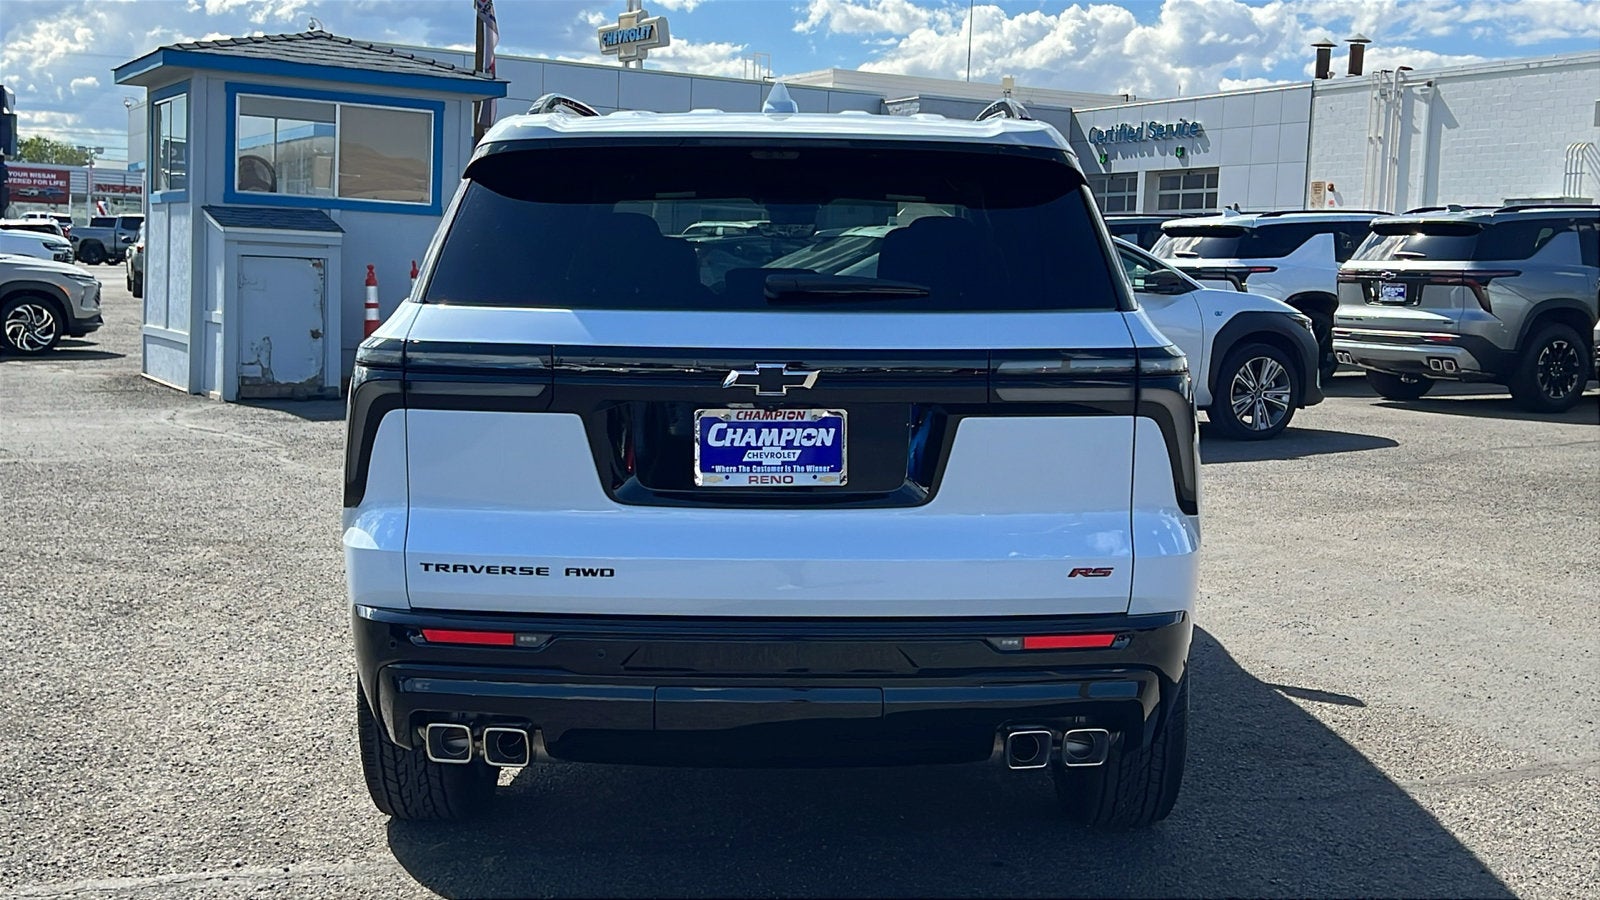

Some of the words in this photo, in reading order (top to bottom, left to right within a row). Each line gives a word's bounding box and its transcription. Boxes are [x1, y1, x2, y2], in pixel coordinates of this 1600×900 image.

[602, 25, 654, 46] CHEVROLET
[1089, 122, 1144, 144] Certified
[1148, 120, 1199, 139] Service
[736, 411, 806, 420] CHAMPION
[738, 465, 751, 473] The
[752, 465, 784, 473] Customer
[793, 465, 805, 473] The
[748, 475, 794, 484] RENO
[420, 562, 550, 576] TRAVERSE
[564, 567, 615, 577] AWD
[1067, 567, 1114, 578] RS
